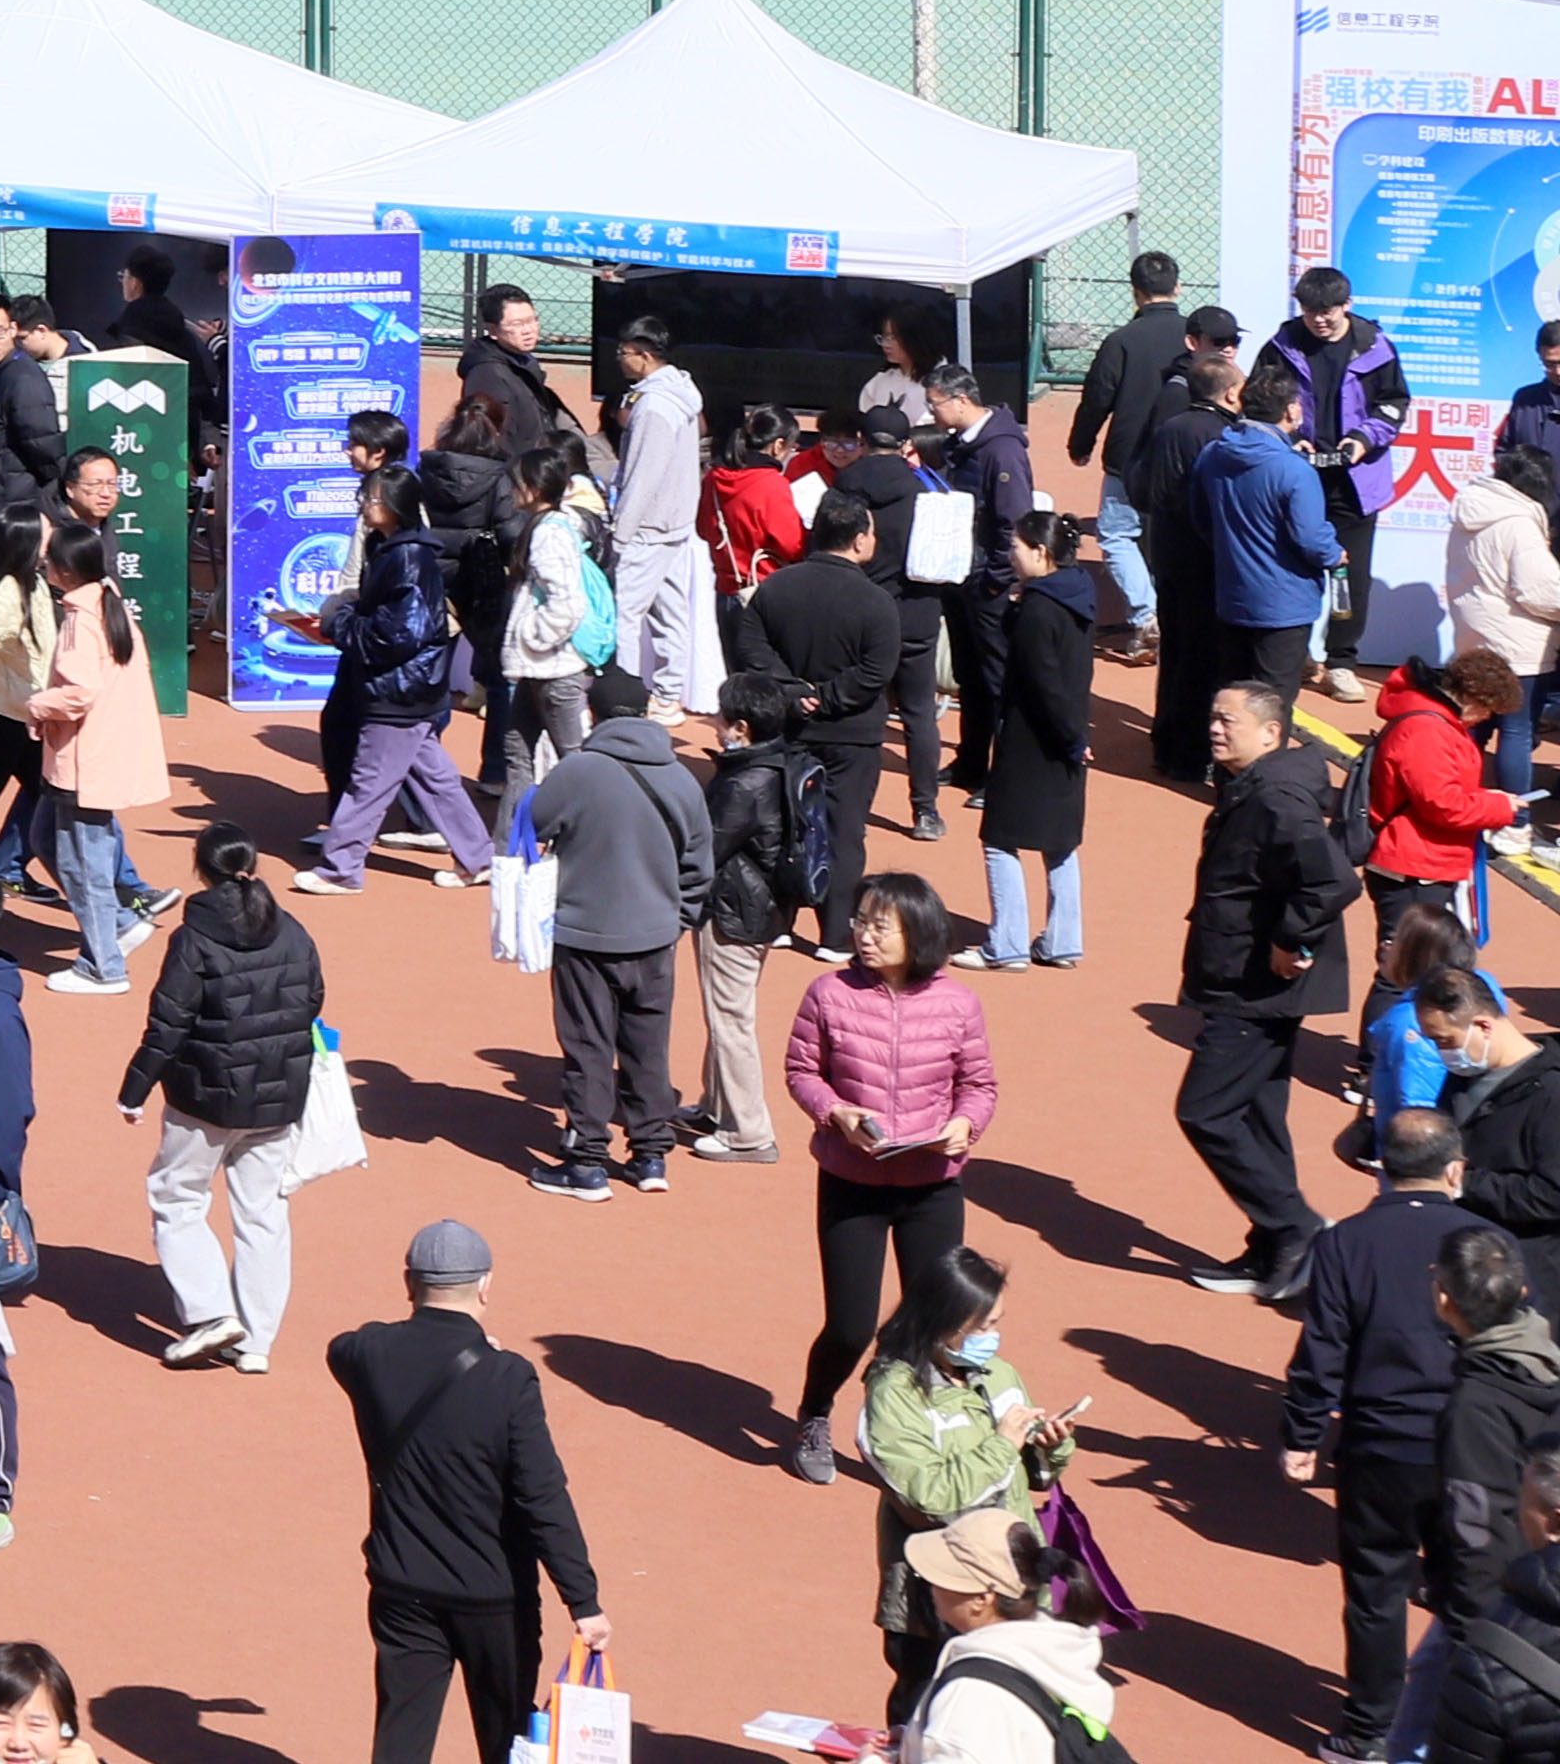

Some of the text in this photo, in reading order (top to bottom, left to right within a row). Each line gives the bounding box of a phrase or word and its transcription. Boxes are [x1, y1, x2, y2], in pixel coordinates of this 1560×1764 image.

[1337, 12, 1440, 29] 信息工程学院
[1325, 76, 1557, 116] 强校有我 AL
[511, 215, 689, 249] 信息工程学院
[1438, 402, 1491, 428] 印刷
[1377, 409, 1475, 512] 大
[1446, 454, 1485, 473] 出版
